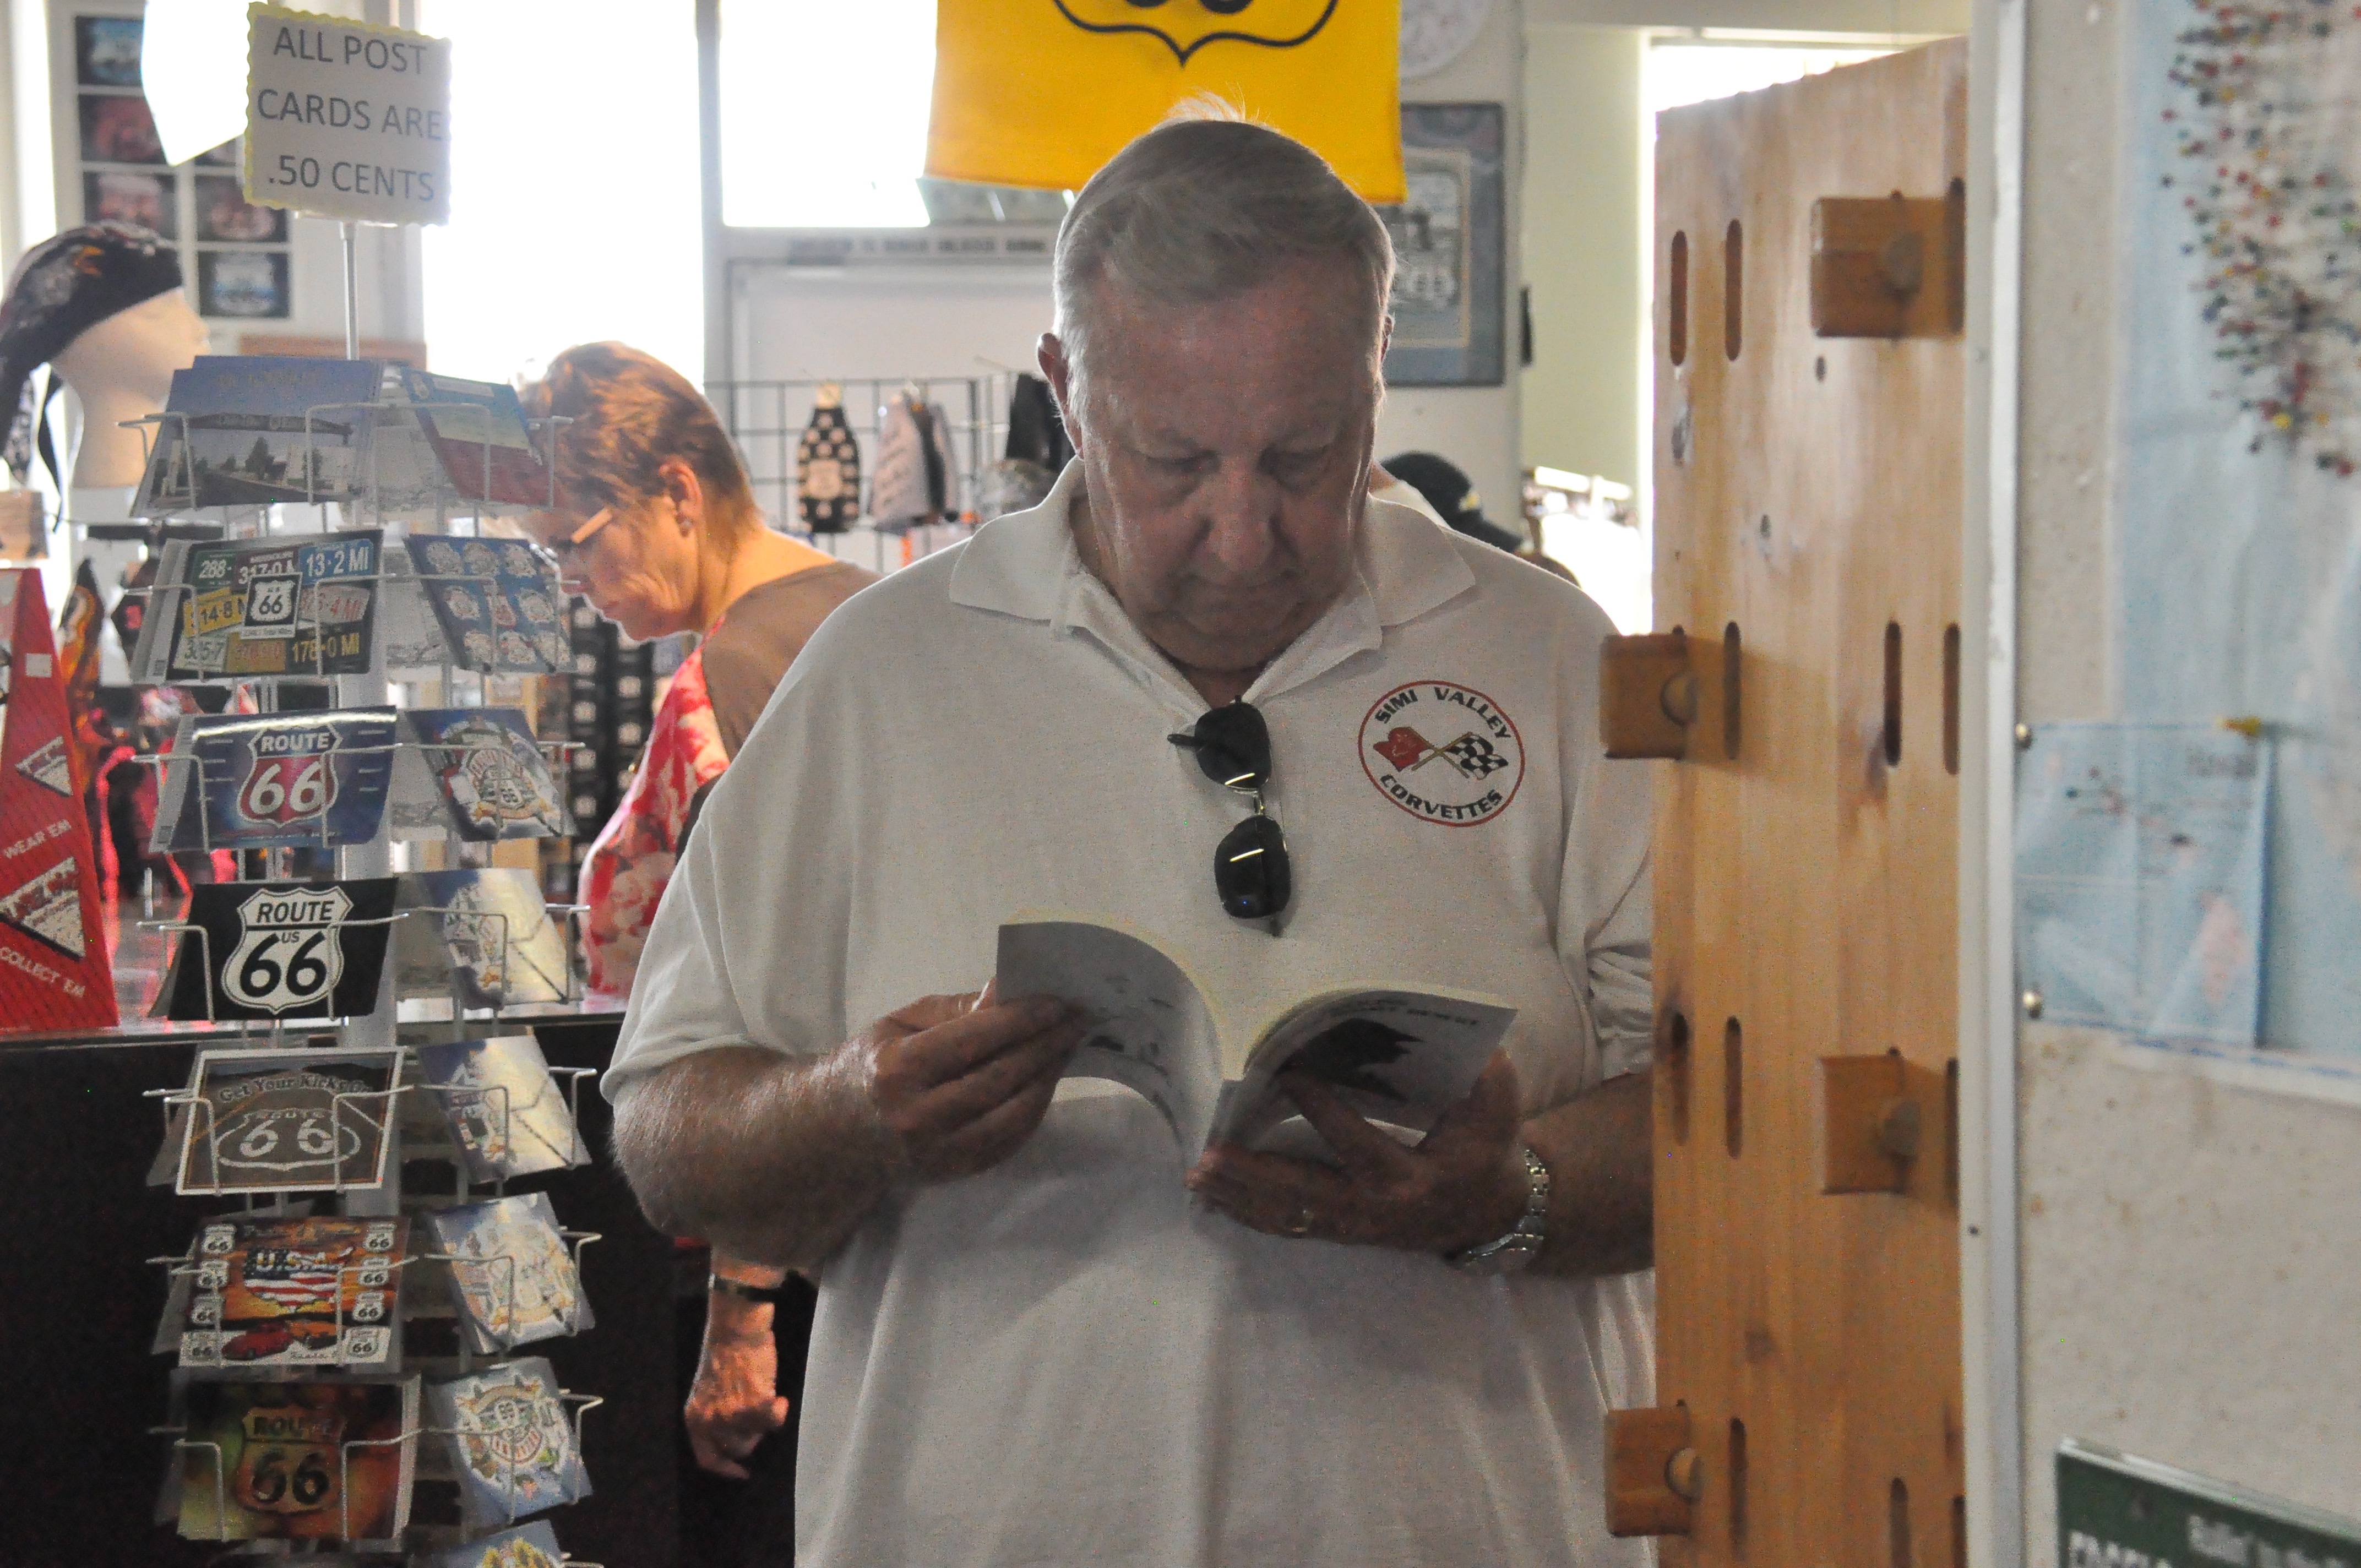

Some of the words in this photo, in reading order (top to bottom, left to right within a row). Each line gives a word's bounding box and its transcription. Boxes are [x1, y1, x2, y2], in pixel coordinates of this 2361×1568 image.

[273, 26, 333, 62] ALL
[344, 35, 427, 75] POST
[257, 89, 371, 131] CARDS
[381, 105, 442, 141] ARE
[269, 155, 321, 188] .50
[331, 161, 434, 202] CENTS
[348, 546, 369, 572] MI
[259, 595, 283, 615] 66
[1374, 689, 1418, 724] SIMI
[1433, 687, 1512, 739] VALLEY
[261, 732, 330, 752] ROUTE
[249, 761, 326, 815] 66
[1379, 774, 1503, 820] CORVETTES
[4, 831, 47, 859] WEAR
[256, 900, 335, 923] ROUTE
[281, 932, 300, 944] US
[240, 930, 328, 998] 66
[240, 1118, 334, 1157] 66
[252, 1449, 330, 1505] 66
